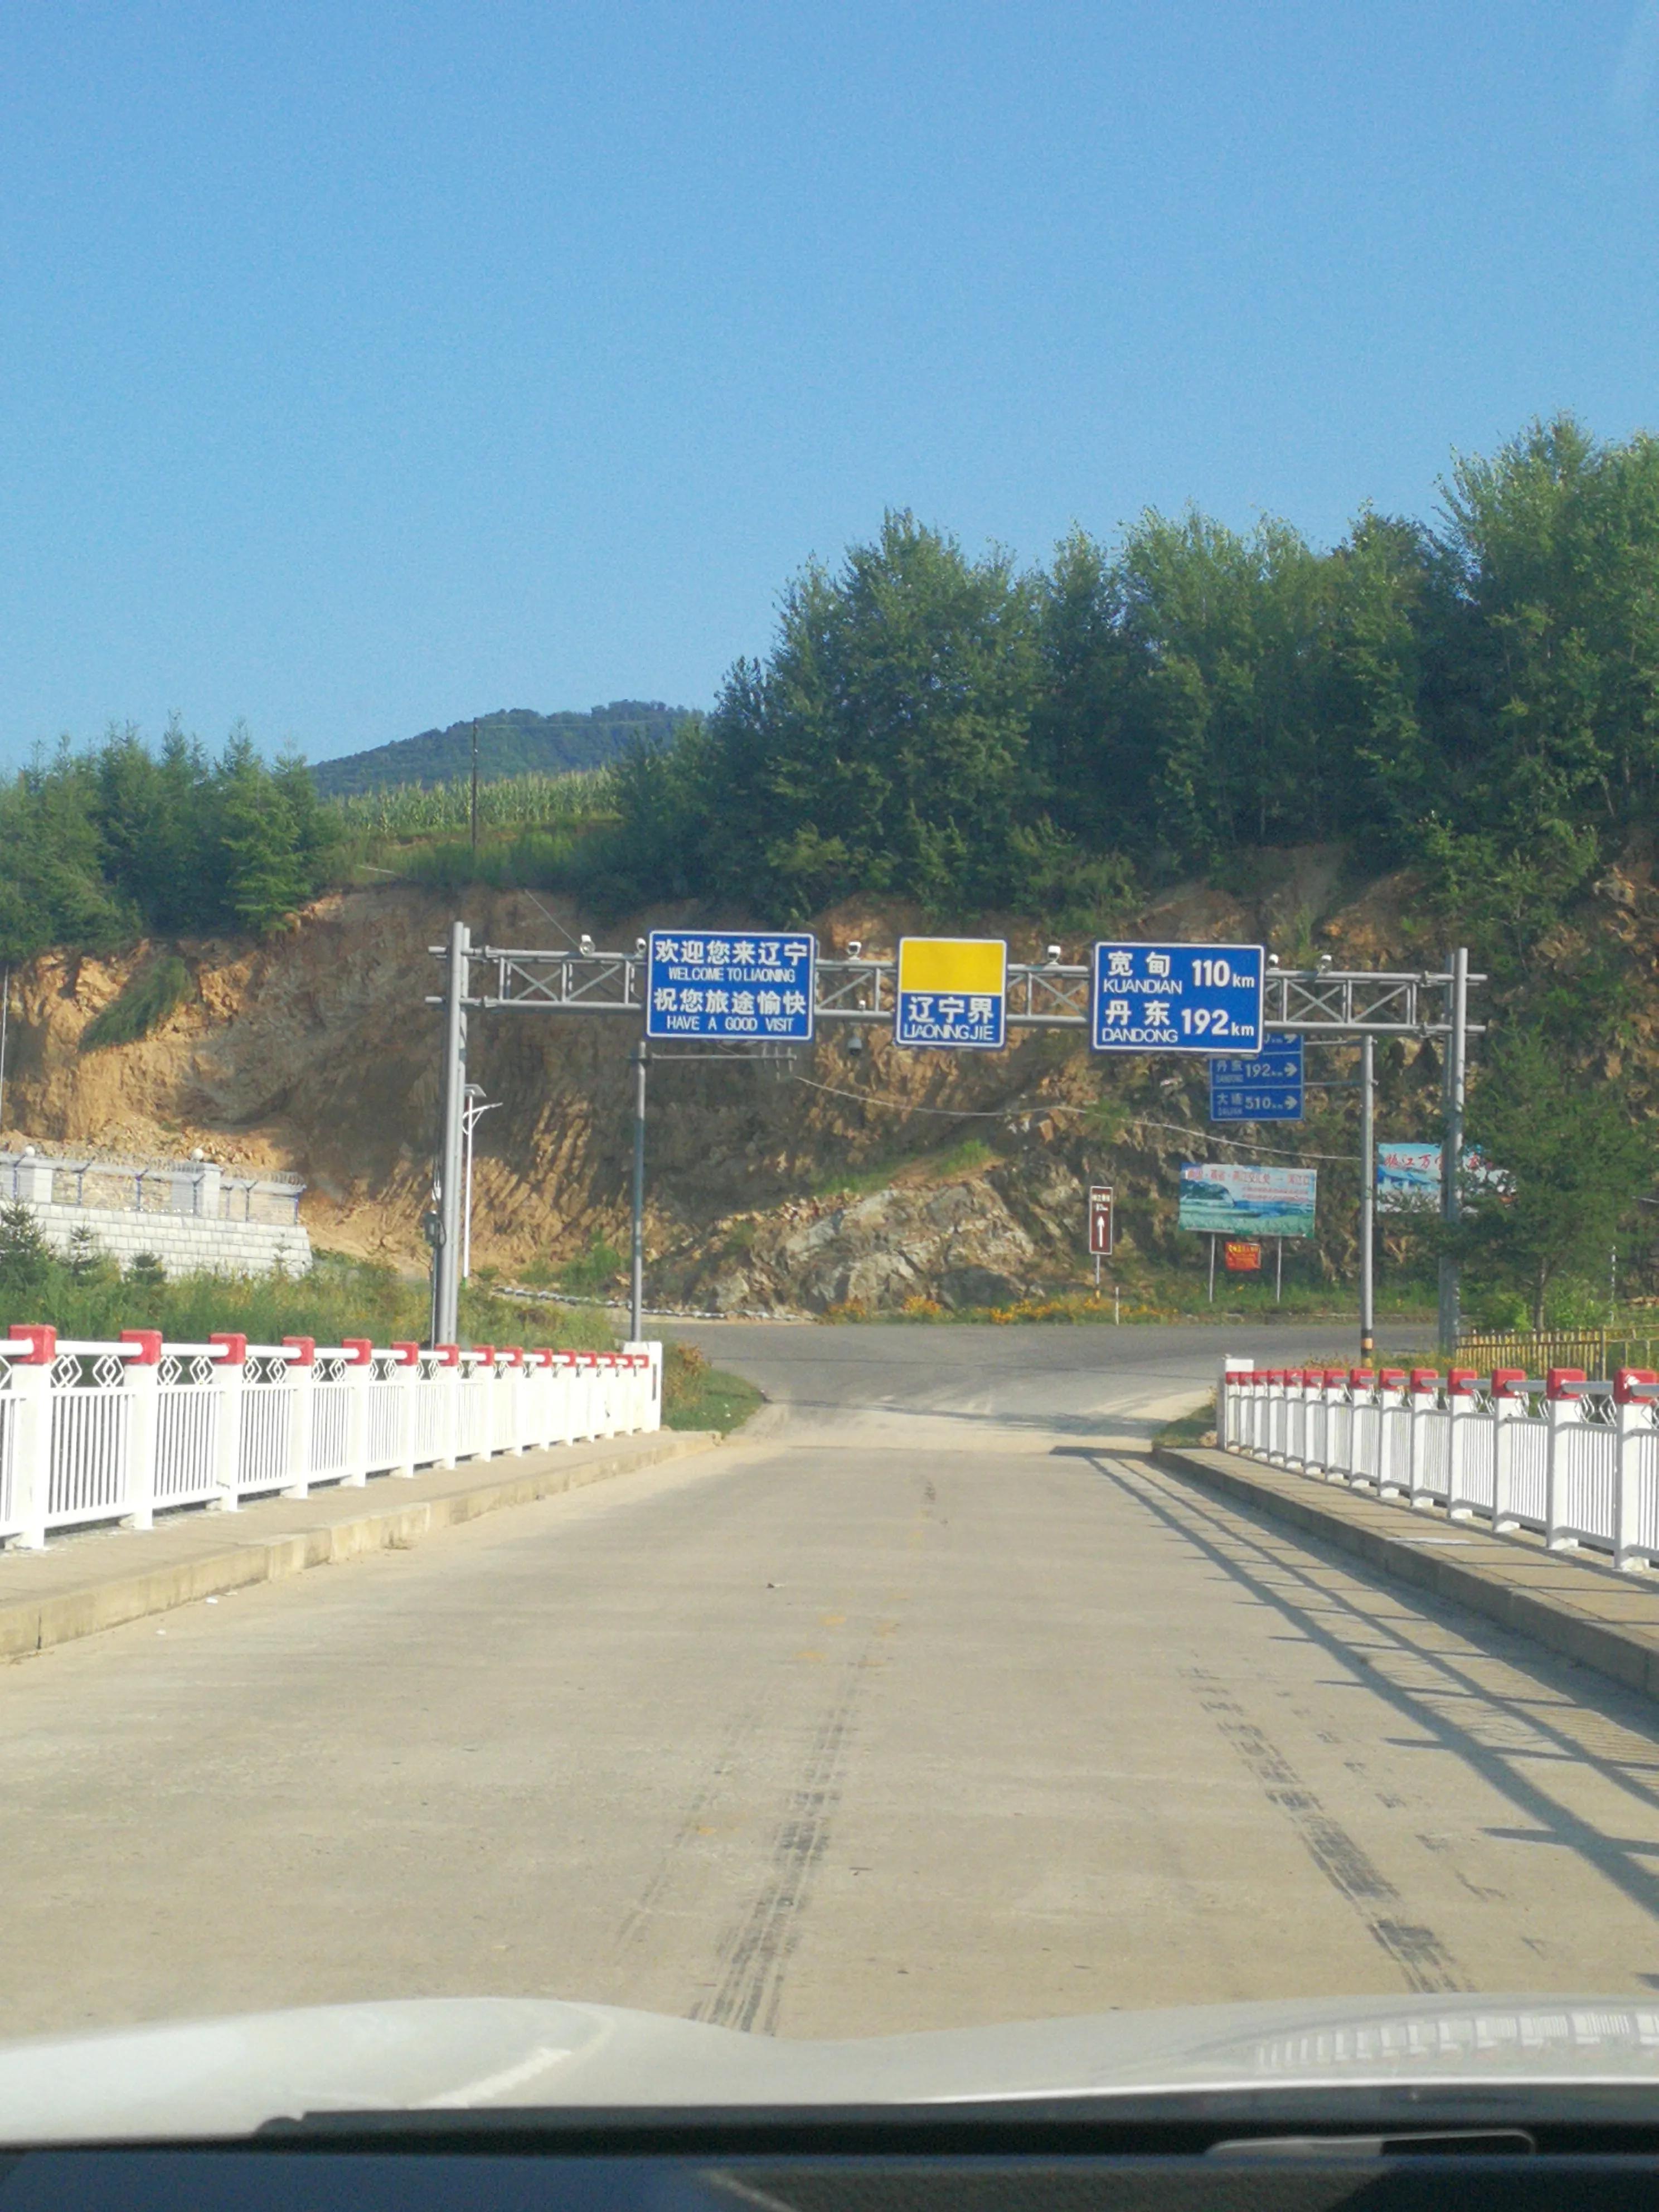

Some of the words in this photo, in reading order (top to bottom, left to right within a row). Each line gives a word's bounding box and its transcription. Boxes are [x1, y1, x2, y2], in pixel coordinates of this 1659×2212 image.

[655, 939, 807, 966] 欢迎您来辽宁
[669, 967, 724, 981] WELCOME
[727, 968, 742, 982] TO
[744, 968, 795, 983] LIAONING
[1108, 950, 1171, 978] 宽甸
[1192, 959, 1231, 987] 110
[1233, 973, 1255, 988] km
[1103, 979, 1182, 995] KUANDIAN
[654, 988, 807, 1015] 祝您旅途愉快
[908, 996, 994, 1024] 辽宁界
[1105, 1000, 1170, 1026] 丹东
[1181, 1008, 1229, 1036] 192
[1231, 1022, 1254, 1036] km
[667, 1016, 700, 1030] HAVE
[708, 1016, 717, 1031] A
[725, 1016, 758, 1031] GOOD
[765, 1017, 794, 1032] VISIT
[1102, 1028, 1178, 1043] DANDONG
[1245, 1064, 1271, 1078] 192
[1245, 1097, 1272, 1109] 510
